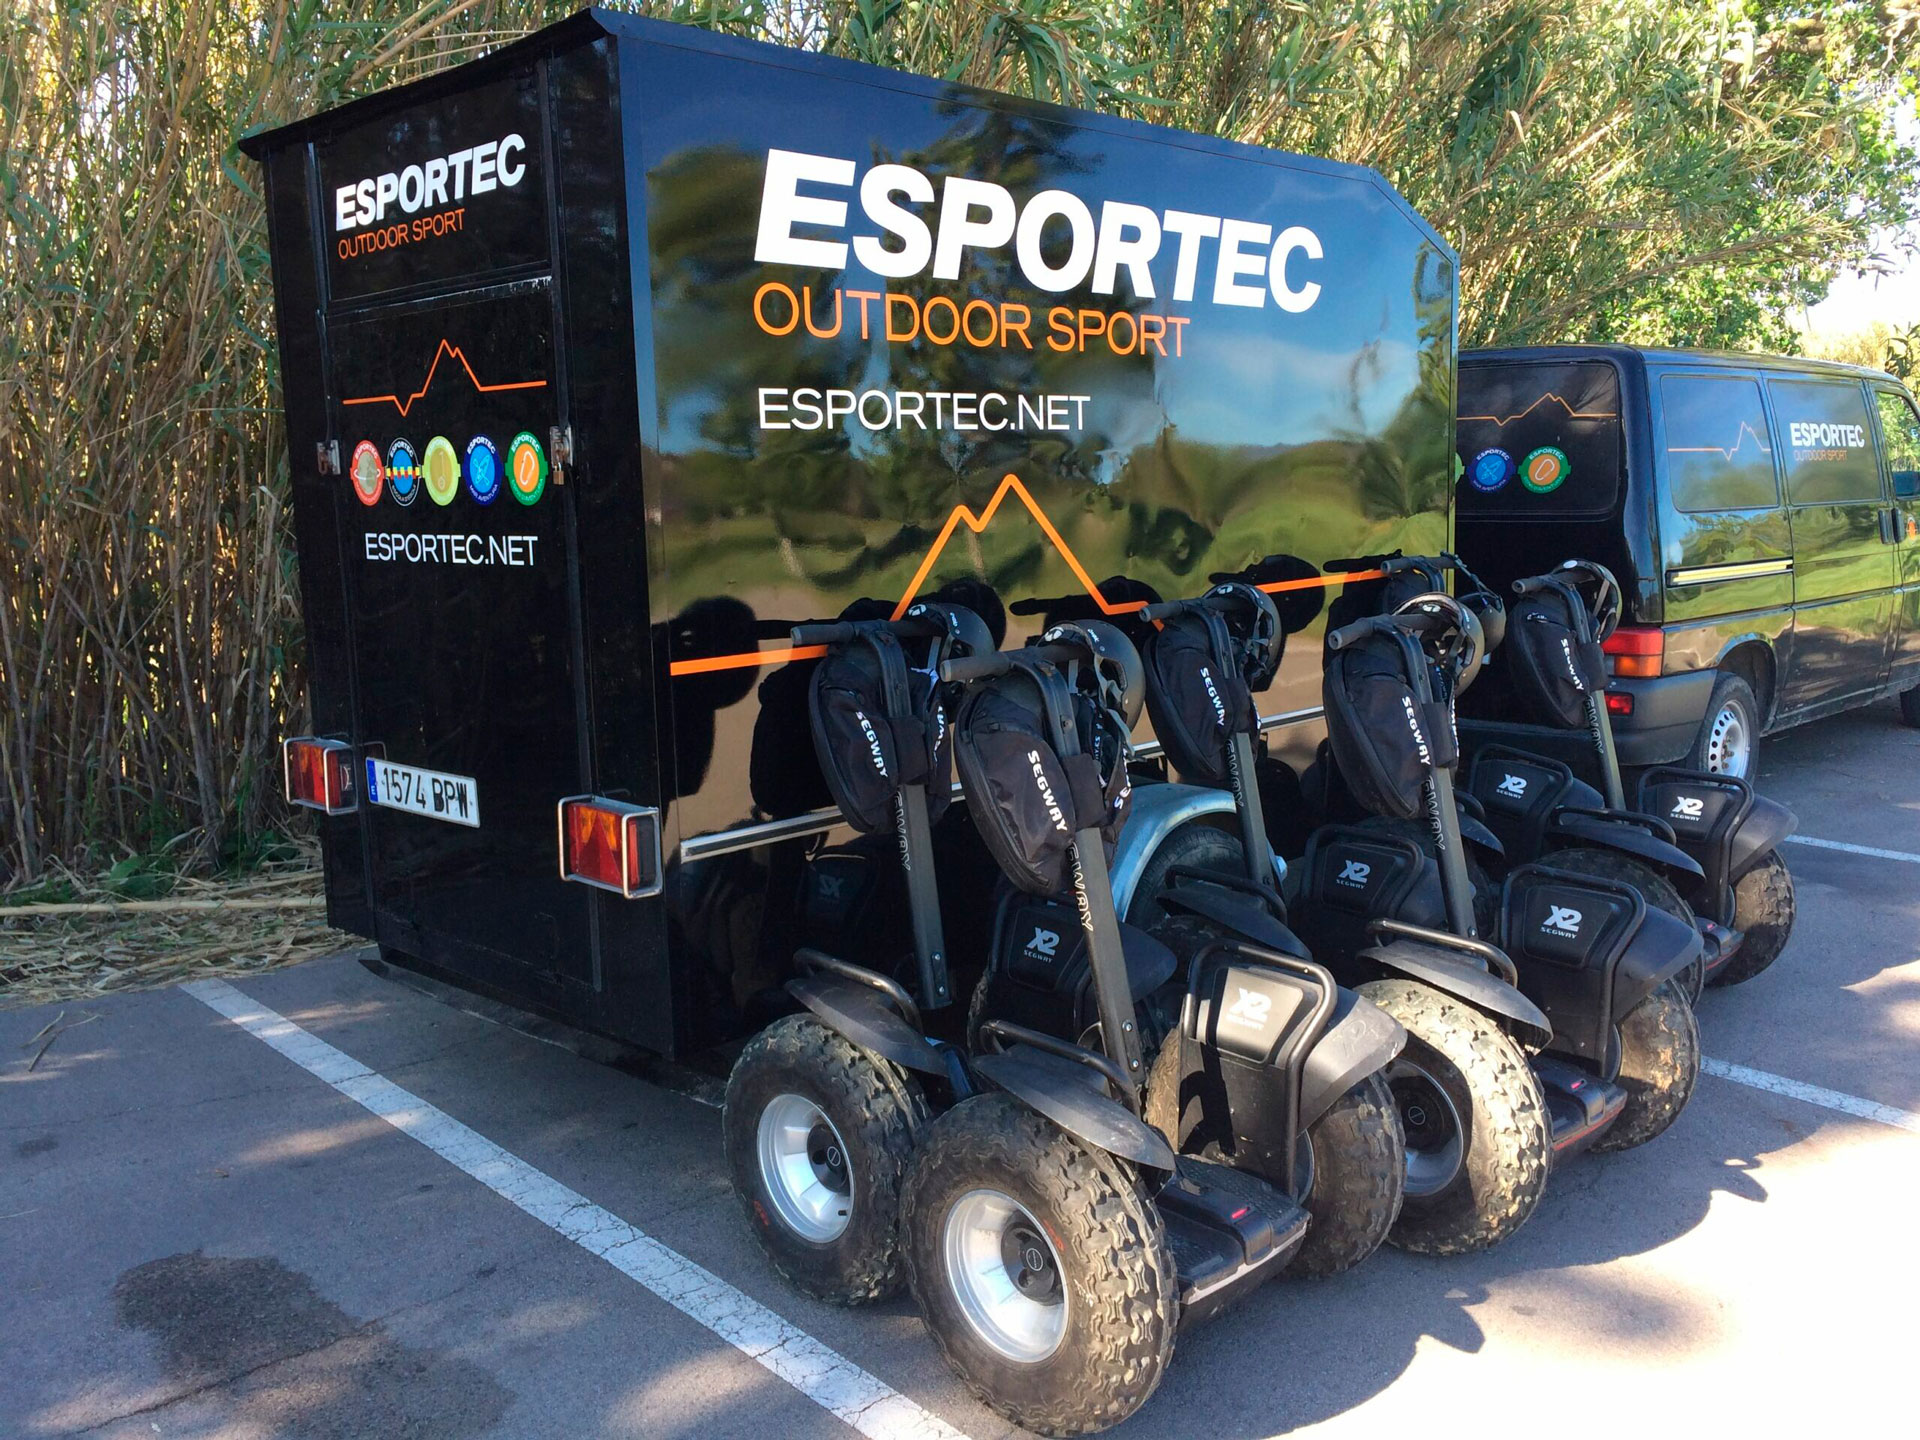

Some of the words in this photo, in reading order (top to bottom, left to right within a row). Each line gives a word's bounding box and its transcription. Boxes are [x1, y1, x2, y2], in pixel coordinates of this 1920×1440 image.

[336, 133, 526, 232] ESPORTEC
[338, 223, 409, 260] OUTDOOR
[412, 208, 465, 241] SPORT
[753, 148, 1325, 313] ESPORTEC
[753, 281, 1033, 350] OUTDOOR
[1046, 306, 1190, 357] SPORT
[758, 387, 1091, 431] ESPORTEC.NET
[467, 436, 496, 454] ESPORTEC
[511, 434, 540, 453] ESPORTEC
[1789, 422, 1865, 448] ESPORTEC
[389, 441, 413, 458] ESPORTEC
[1476, 448, 1510, 461] ESPORTEC
[1529, 448, 1564, 461] ESPORTEC
[1793, 449, 1827, 461] OUTDOOR
[1828, 449, 1848, 461] SPORT
[364, 532, 538, 566] ESPORTEC.NET
[1200, 667, 1225, 726] SEGWAY
[1402, 695, 1431, 765] SEGWAY
[855, 711, 888, 778] SEGWAY
[383, 767, 426, 809] 1574
[431, 777, 468, 818] BPW
[1027, 750, 1067, 831] SEGWAY
[1498, 773, 1527, 794] X2
[1670, 812, 1700, 822] SEGWAY
[1671, 796, 1704, 816] X2
[1336, 879, 1365, 890] SEGWAY
[1338, 859, 1370, 883] X2
[1543, 904, 1582, 932] X2
[1026, 927, 1060, 956] X2
[1540, 926, 1577, 939] SEGWAY
[1023, 949, 1053, 963] SEGWAY
[1229, 987, 1272, 1022] X2
